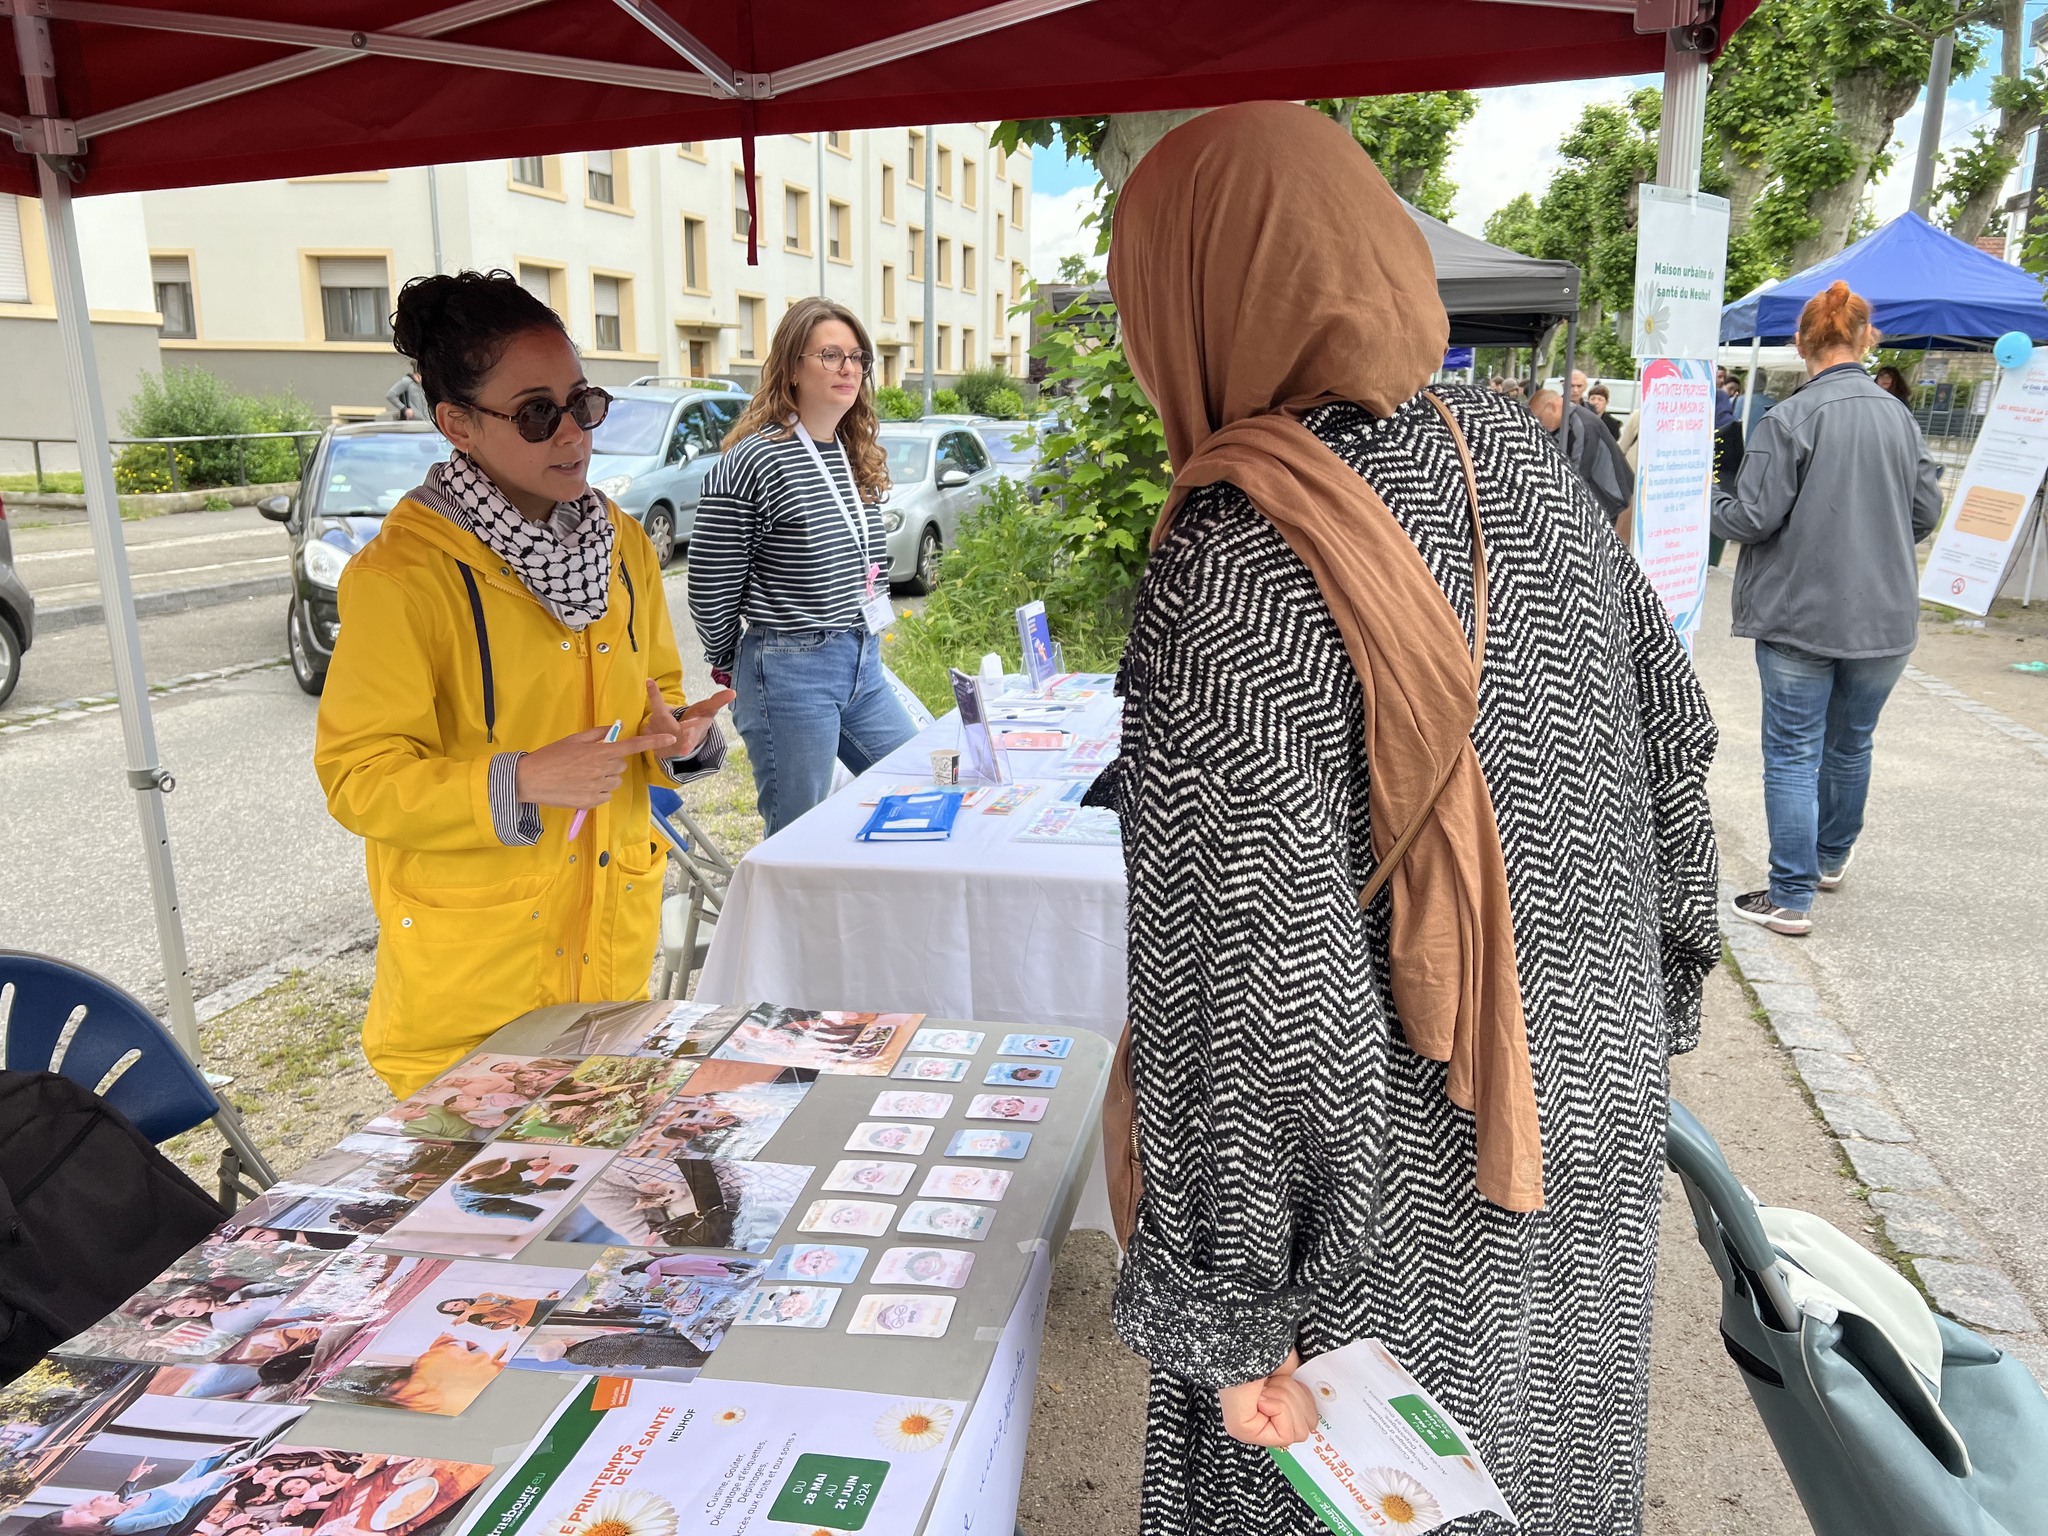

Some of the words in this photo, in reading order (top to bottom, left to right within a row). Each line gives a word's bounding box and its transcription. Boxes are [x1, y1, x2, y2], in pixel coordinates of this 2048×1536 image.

[1655, 262, 1681, 276] Maison
[1683, 266, 1707, 280] urbaine
[1708, 269, 1714, 280] de
[1657, 286, 1678, 298] santé
[1680, 288, 1688, 299] du
[668, 1408, 696, 1443] NEUHOF
[1318, 1413, 1332, 1430] NEU
[1411, 1413, 1427, 1428] MAI
[1412, 1421, 1425, 1433] DU
[1422, 1409, 1442, 1428] JUIN
[1425, 1420, 1437, 1430] AU
[610, 1467, 632, 1486] DE
[624, 1449, 646, 1472] LA
[639, 1406, 675, 1446] SANTÉ
[781, 1438, 795, 1455] soins
[1324, 1443, 1339, 1459] LA
[772, 1456, 785, 1470] aux
[1337, 1460, 1355, 1477] DE
[707, 1479, 730, 1508] Cuisine,
[724, 1453, 746, 1479] Goûter,
[710, 1486, 742, 1526] Décryptage
[737, 1440, 767, 1482] d'étiquettes,
[737, 1462, 769, 1503] Dépistages,
[770, 1470, 777, 1479] et
[1313, 1445, 1372, 1511] PRINTEMPS
[568, 1445, 632, 1522] PRINTEMPS
[756, 1478, 772, 1499] droits
[792, 1480, 807, 1494] DU
[803, 1492, 818, 1505] 28
[812, 1473, 828, 1492] MAI
[825, 1484, 838, 1497] AU
[841, 1476, 859, 1498] JUIN
[854, 1483, 872, 1506] 2024
[487, 1472, 546, 1536] trasbourg.eu
[748, 1500, 760, 1515] aux
[835, 1498, 848, 1510] 21
[1370, 1511, 1387, 1526] LE
